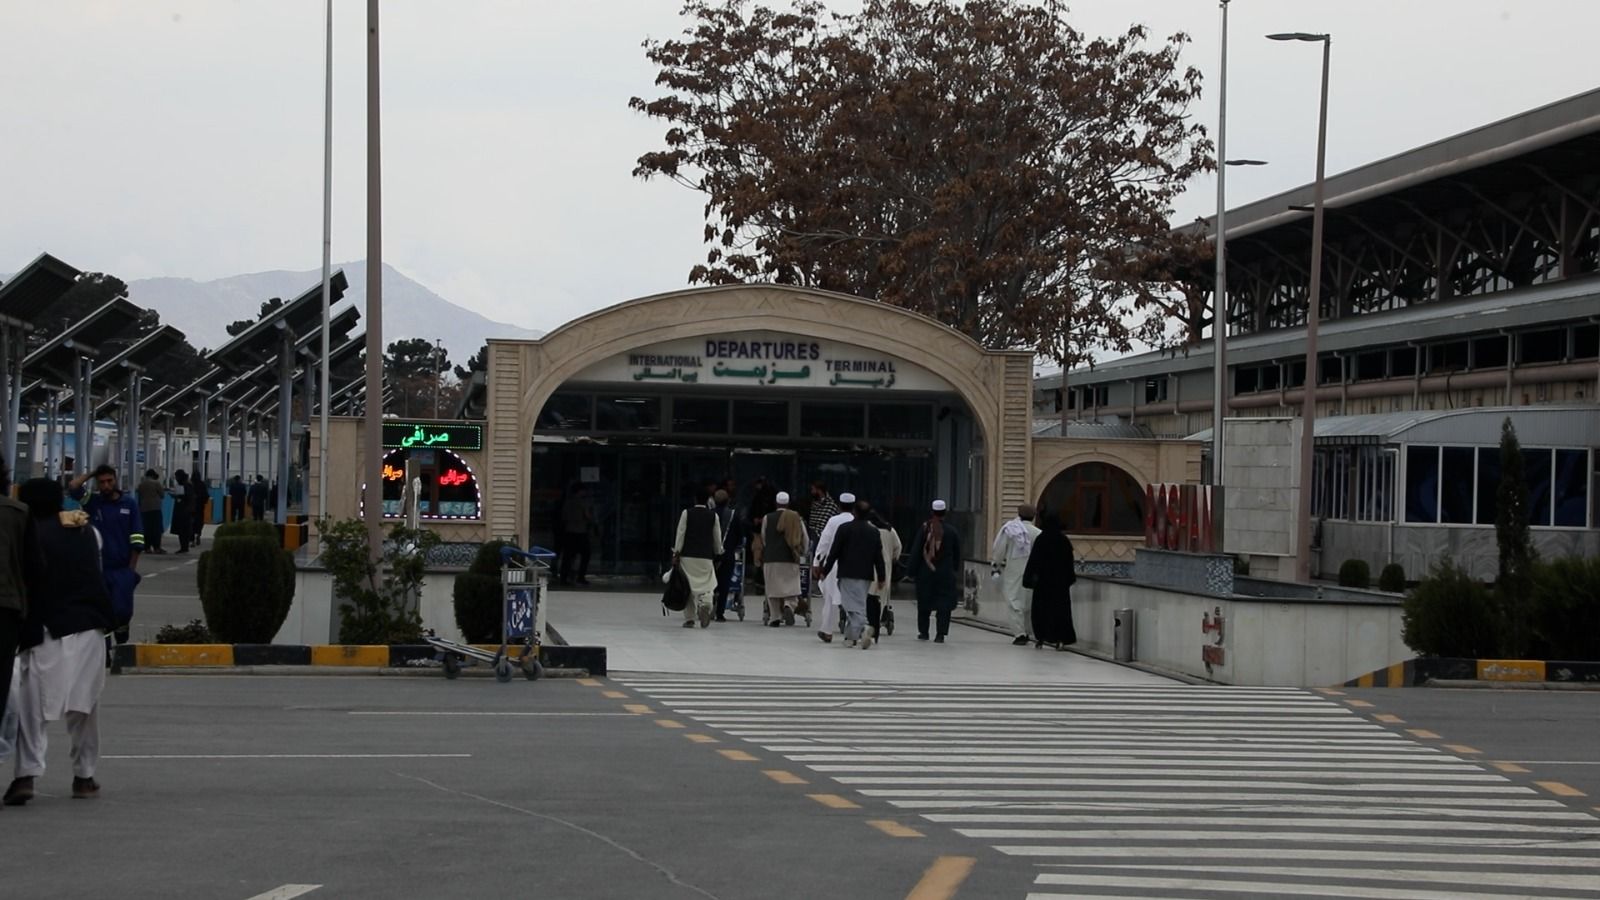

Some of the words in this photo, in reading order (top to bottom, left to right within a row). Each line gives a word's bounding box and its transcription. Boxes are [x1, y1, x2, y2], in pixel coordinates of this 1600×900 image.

[629, 354, 703, 367] INTERNATIONAL
[706, 341, 820, 360] DEPARTURES
[825, 360, 896, 373] TERMINAL
[402, 425, 449, 446] صرافی
